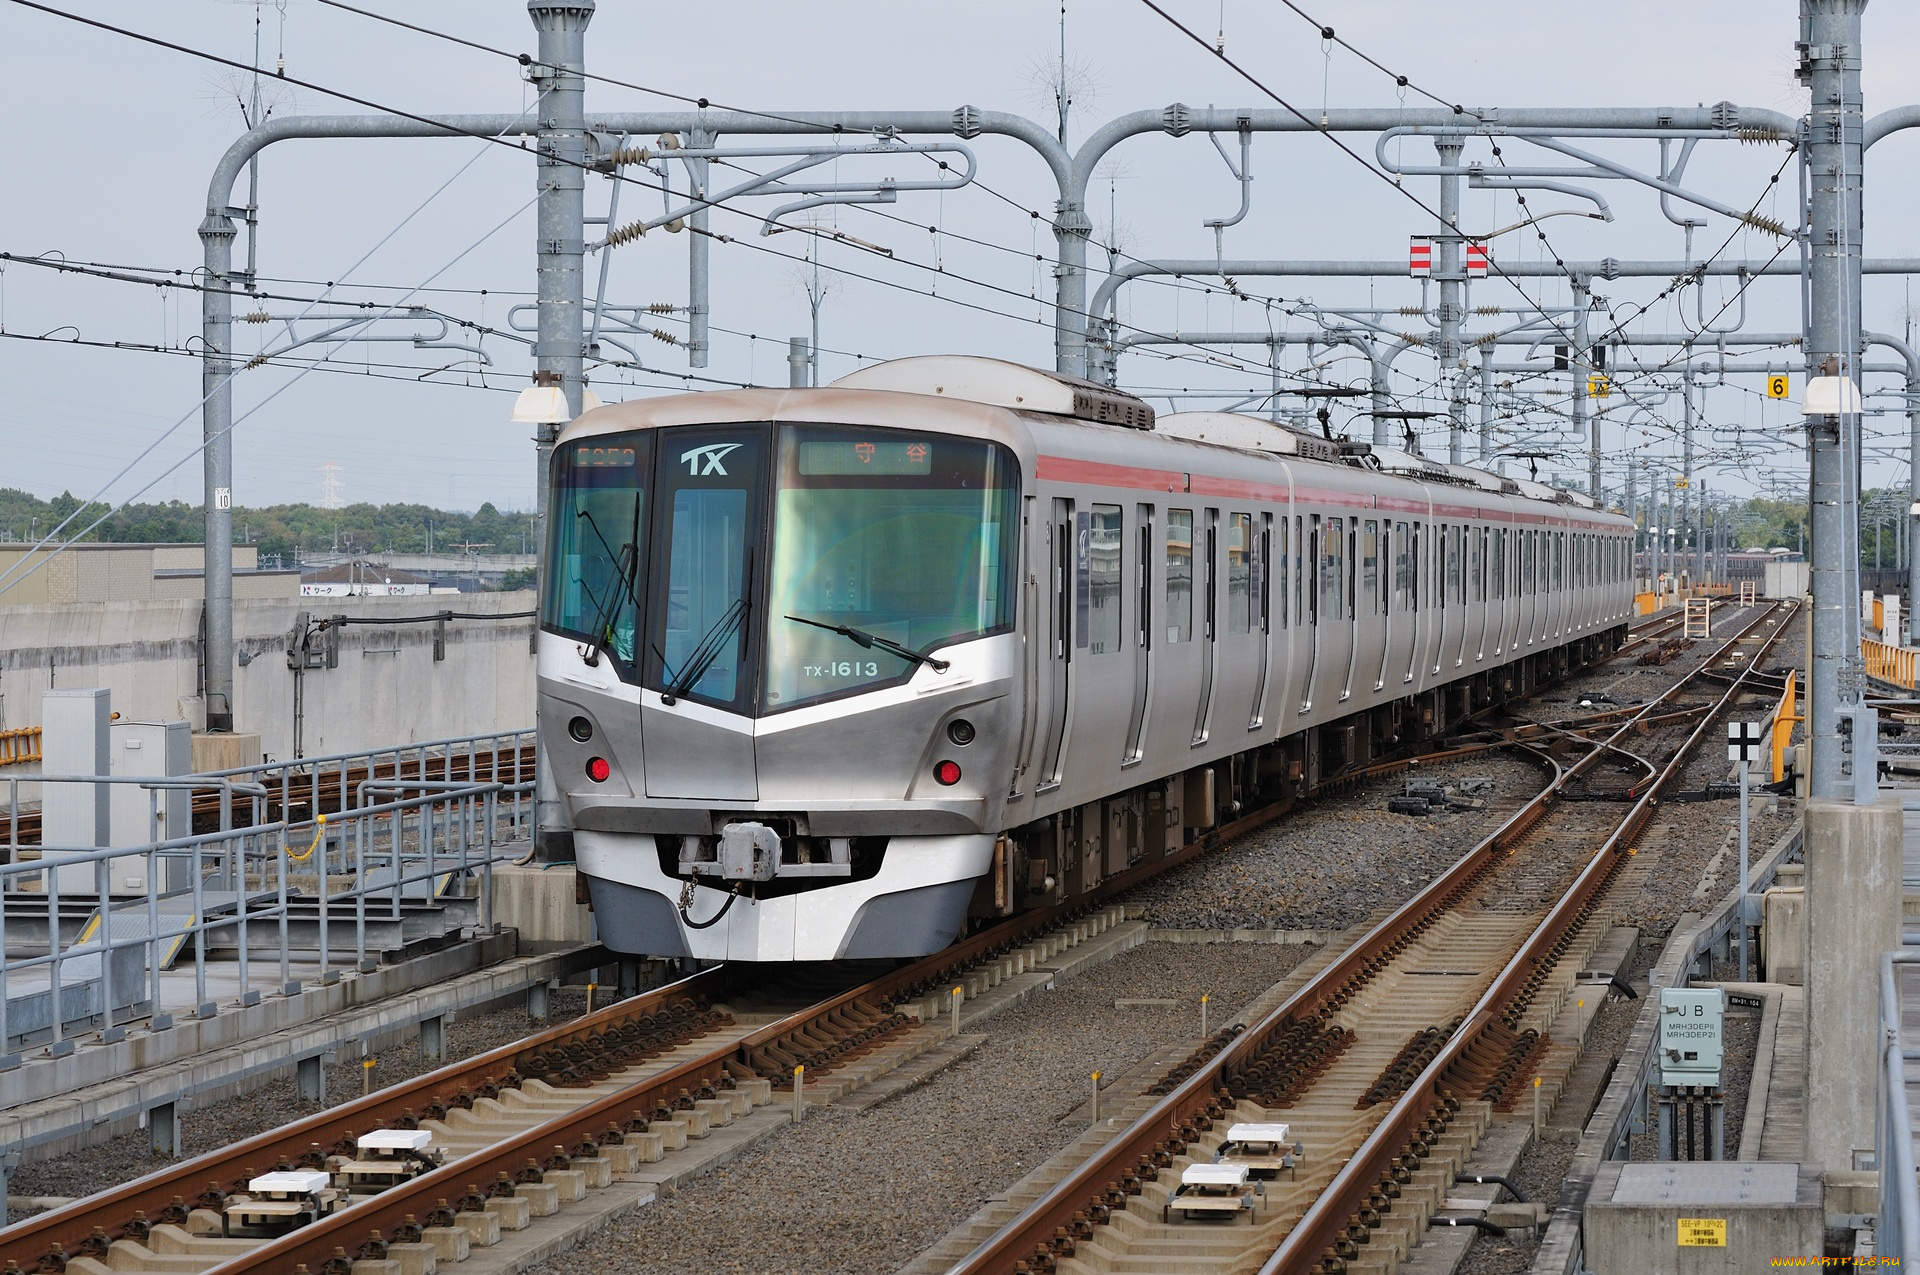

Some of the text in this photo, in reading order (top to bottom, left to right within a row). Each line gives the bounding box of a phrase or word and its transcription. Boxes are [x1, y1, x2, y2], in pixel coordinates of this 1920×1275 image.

[1773, 378, 1784, 395] 6
[681, 443, 743, 476] TX
[220, 495, 229, 507] 10
[803, 661, 878, 677] TX-1613
